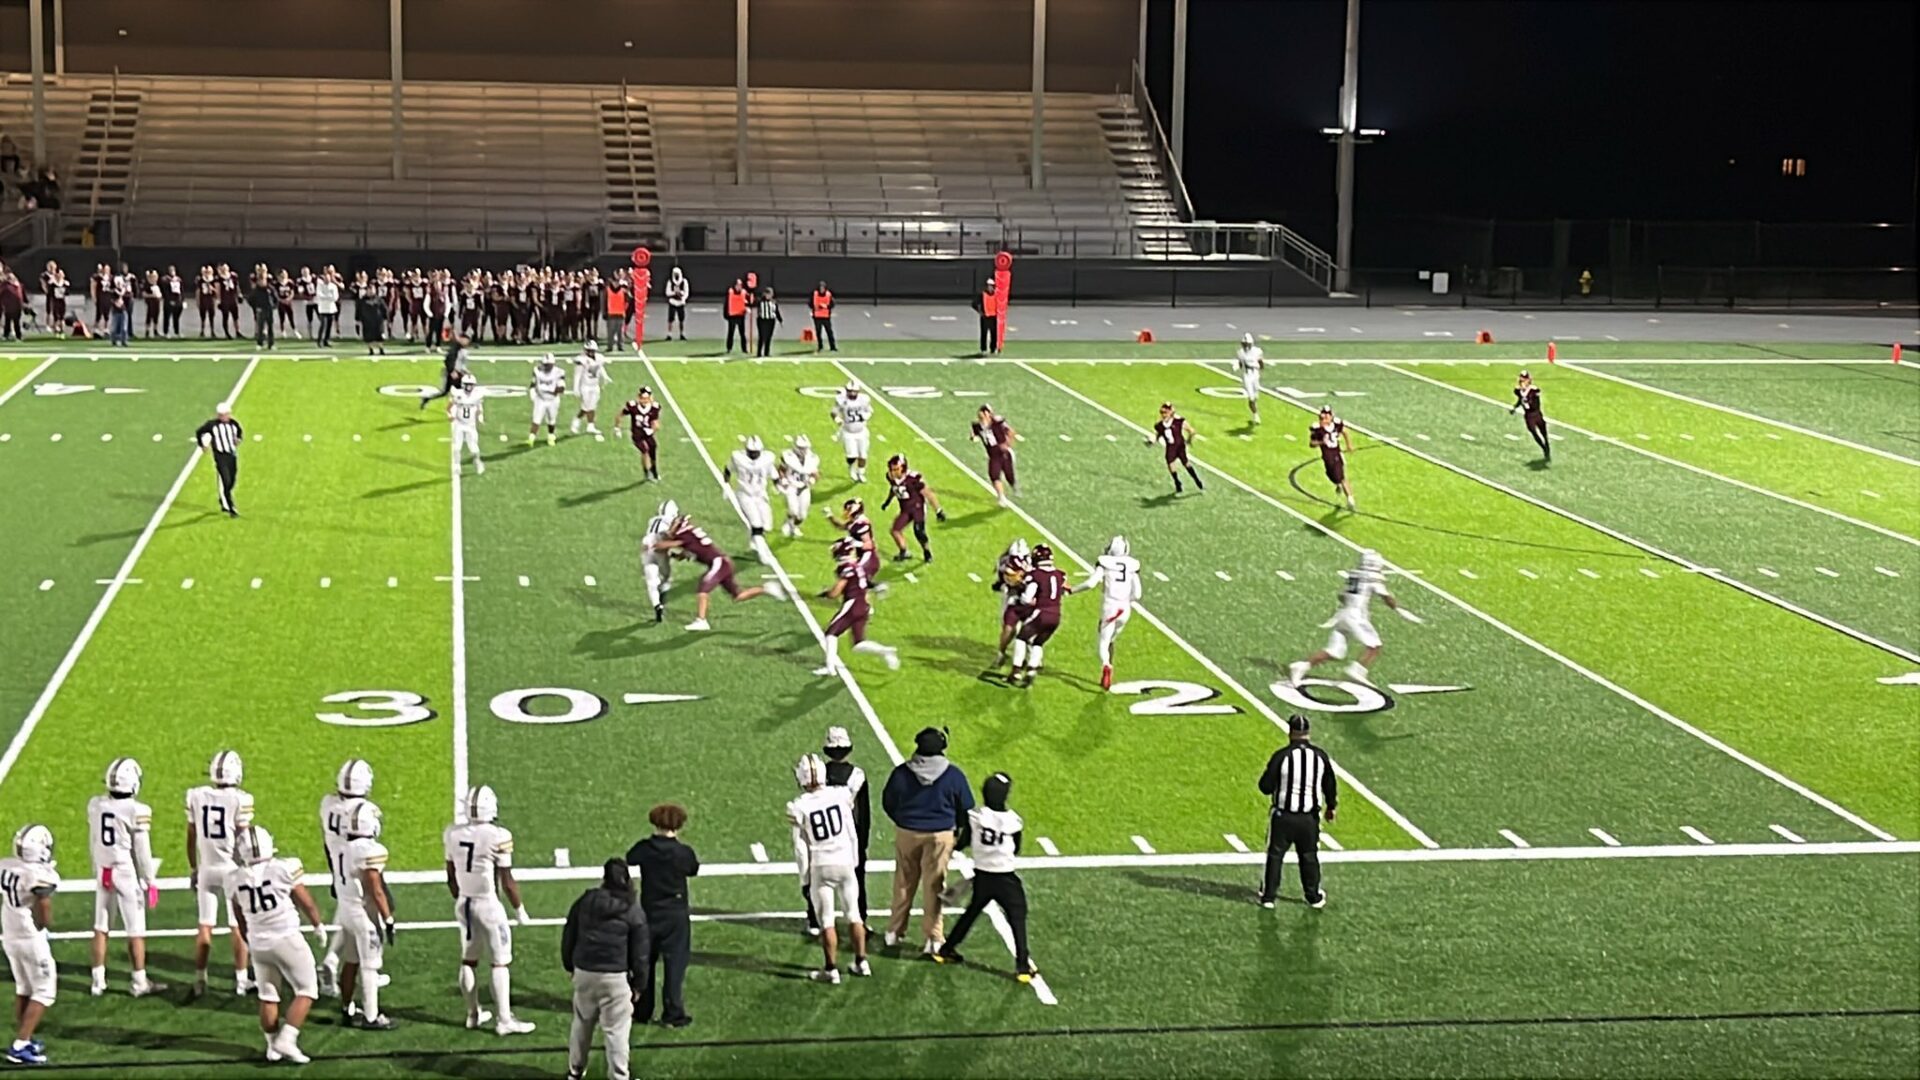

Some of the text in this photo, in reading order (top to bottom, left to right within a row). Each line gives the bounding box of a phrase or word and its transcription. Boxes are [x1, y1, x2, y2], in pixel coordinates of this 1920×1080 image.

[1050, 575, 1058, 600] 1
[1115, 562, 1126, 582] 3
[101, 812, 115, 846] 6
[202, 805, 226, 839] 13
[809, 804, 842, 842] 80
[459, 841, 475, 873] 7
[1, 868, 20, 908] 41
[239, 880, 277, 914] 76
